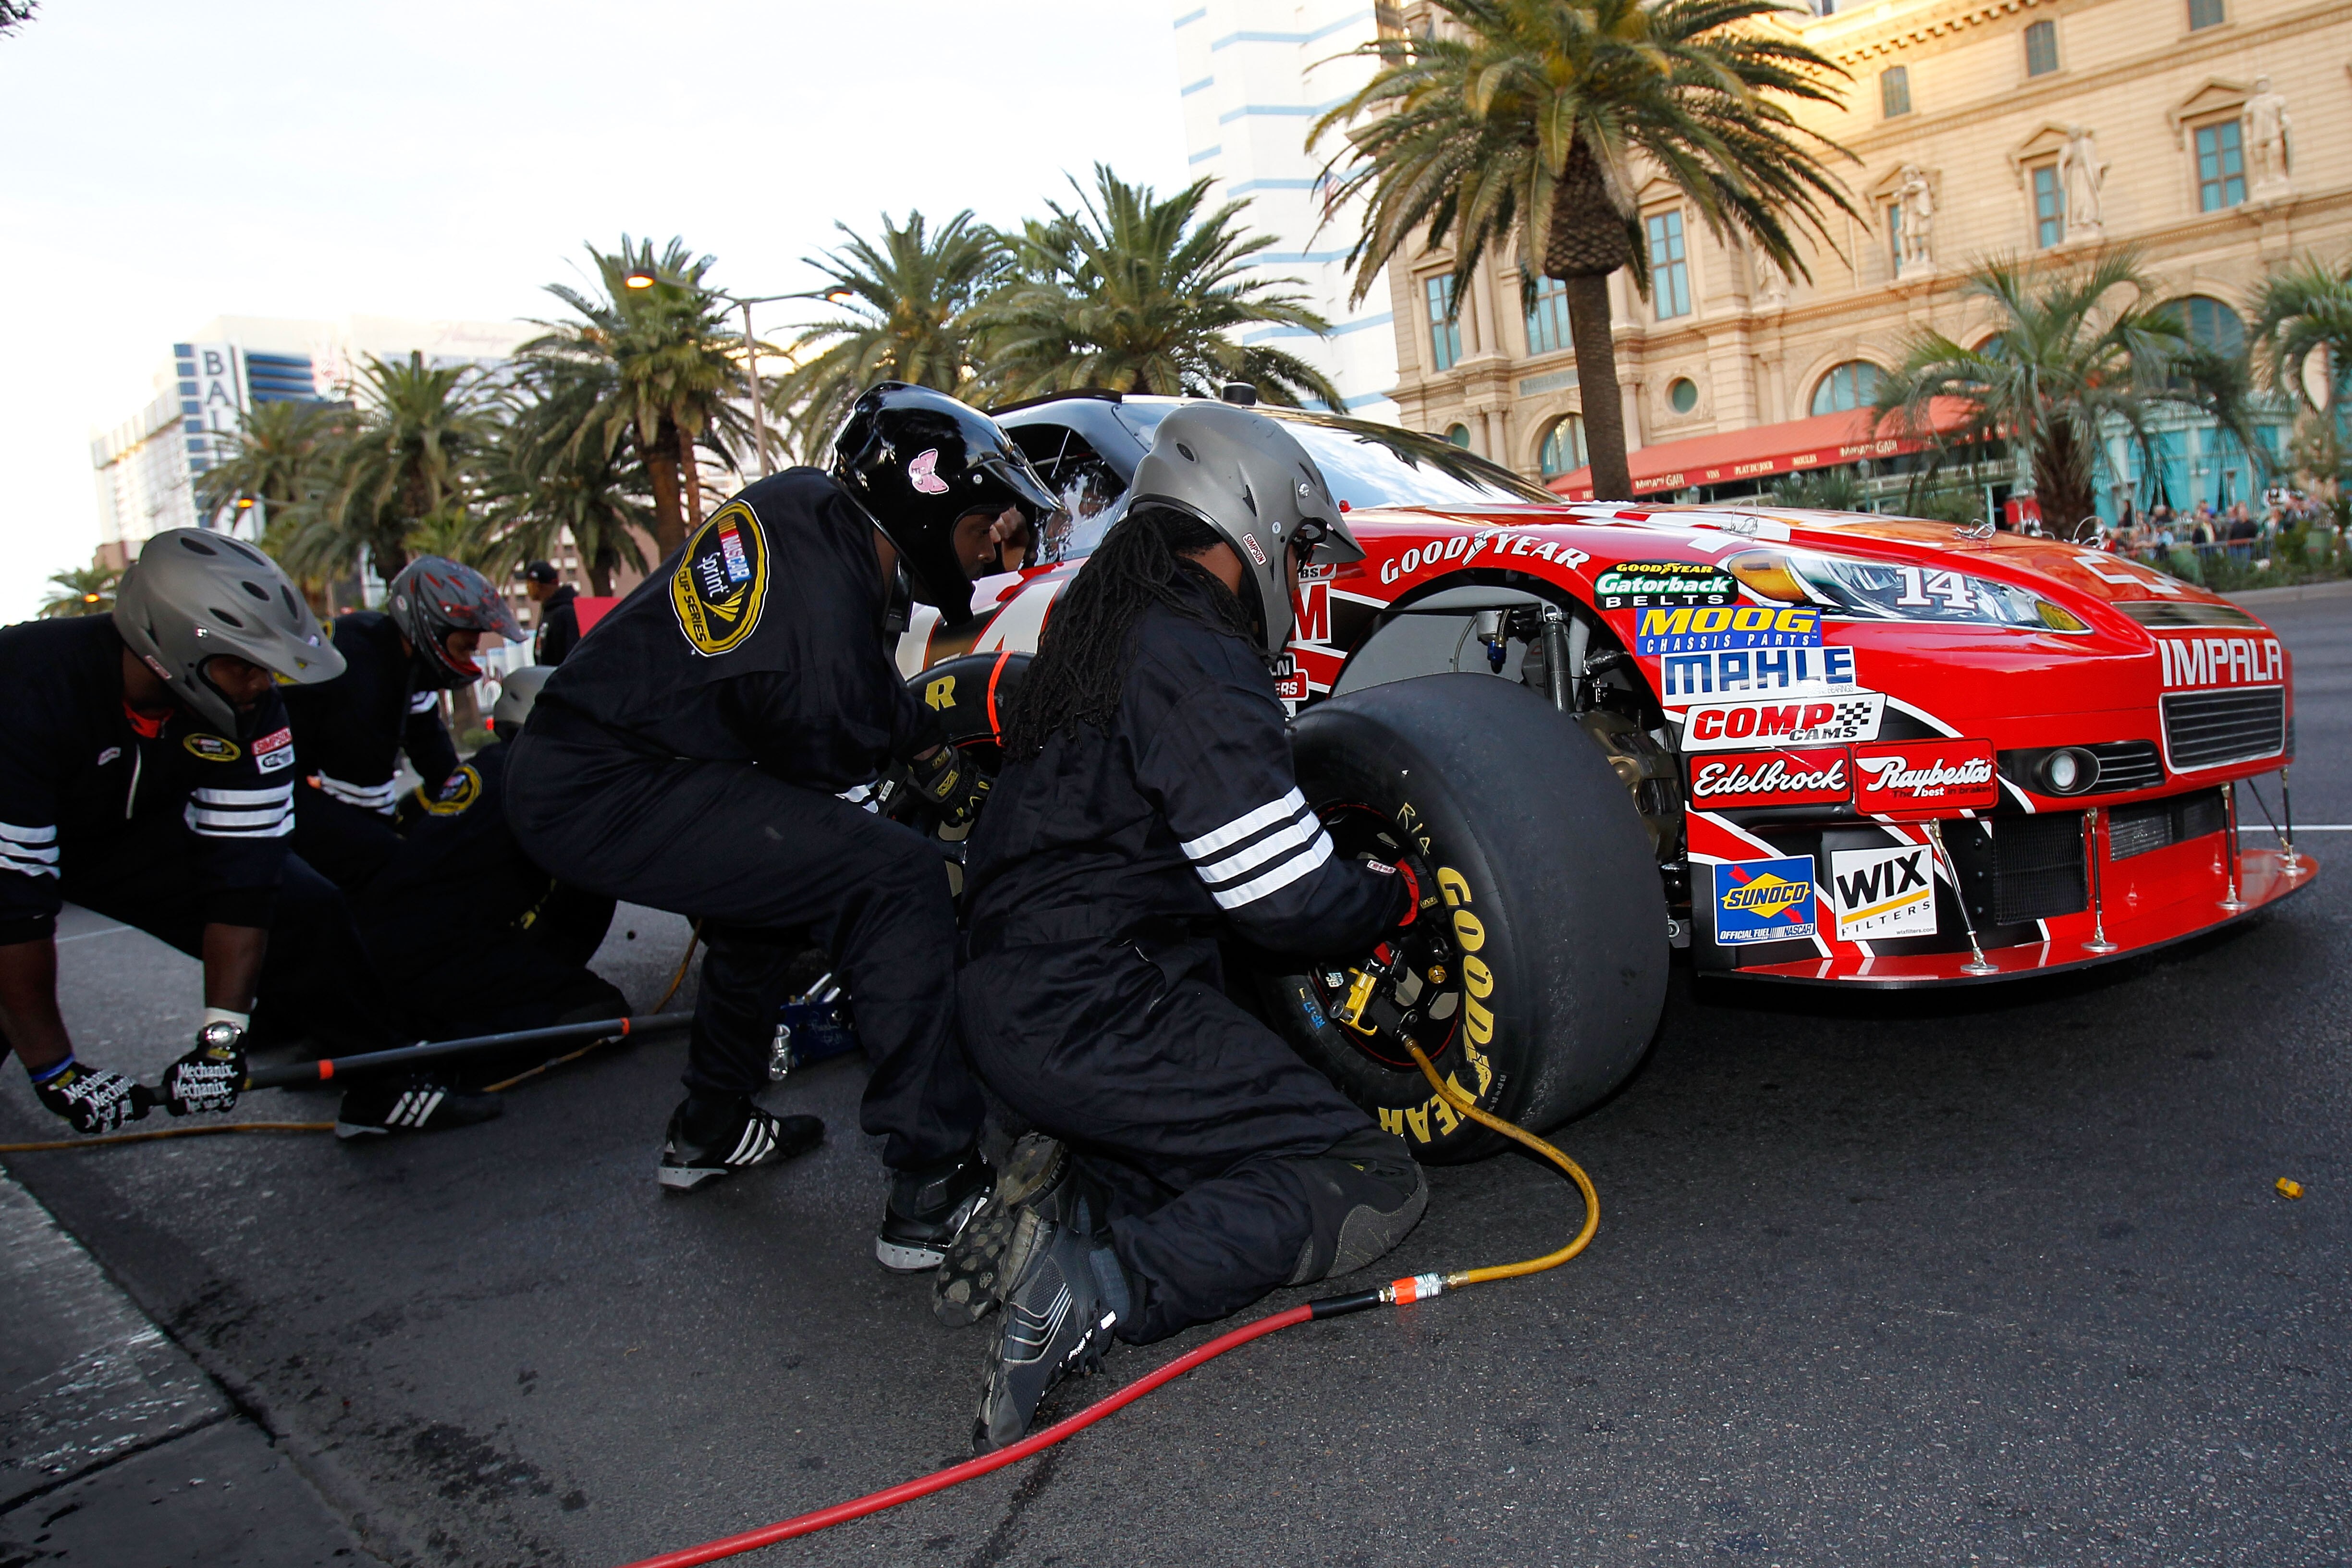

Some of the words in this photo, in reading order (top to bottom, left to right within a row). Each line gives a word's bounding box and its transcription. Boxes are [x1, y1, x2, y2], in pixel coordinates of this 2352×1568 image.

[1706, 469, 1720, 479] VINS
[1793, 454, 1817, 466] MOULES
[721, 534, 751, 581] NASCAR
[1244, 535, 1265, 564] SIMPSON
[1380, 529, 1590, 585] GOODYEAR
[678, 570, 691, 592] CUP
[697, 552, 728, 598] Sprint
[1595, 572, 1732, 595] Gatorback
[1616, 563, 1714, 575] GOODYEAR
[1605, 594, 1724, 608] BELTS
[1896, 566, 1977, 610] 14
[684, 595, 707, 642] SERIES
[1639, 608, 1818, 637] MOOG
[1647, 634, 1731, 653] CHASSIS
[1747, 633, 1809, 647] PARTS
[1666, 648, 1853, 696] MAHLE
[2157, 638, 2283, 687] IMPALA
[1693, 703, 1835, 740] COMP
[1788, 726, 1858, 741] CAMS
[1693, 759, 1847, 797] Edelbrock
[1855, 756, 1993, 797] Raybestos
[1893, 789, 1911, 798] The
[1921, 787, 1945, 797] best
[1959, 785, 1993, 794] brakes
[1836, 850, 1928, 910] WIX
[1727, 884, 1807, 907] SUNOCO
[1720, 930, 1752, 940] OFFICIAL
[1753, 927, 1770, 937] FUEL
[1784, 924, 1812, 936] NASCAR
[1841, 901, 1931, 937] FILTERS
[1896, 927, 1935, 935] wixfilters.com
